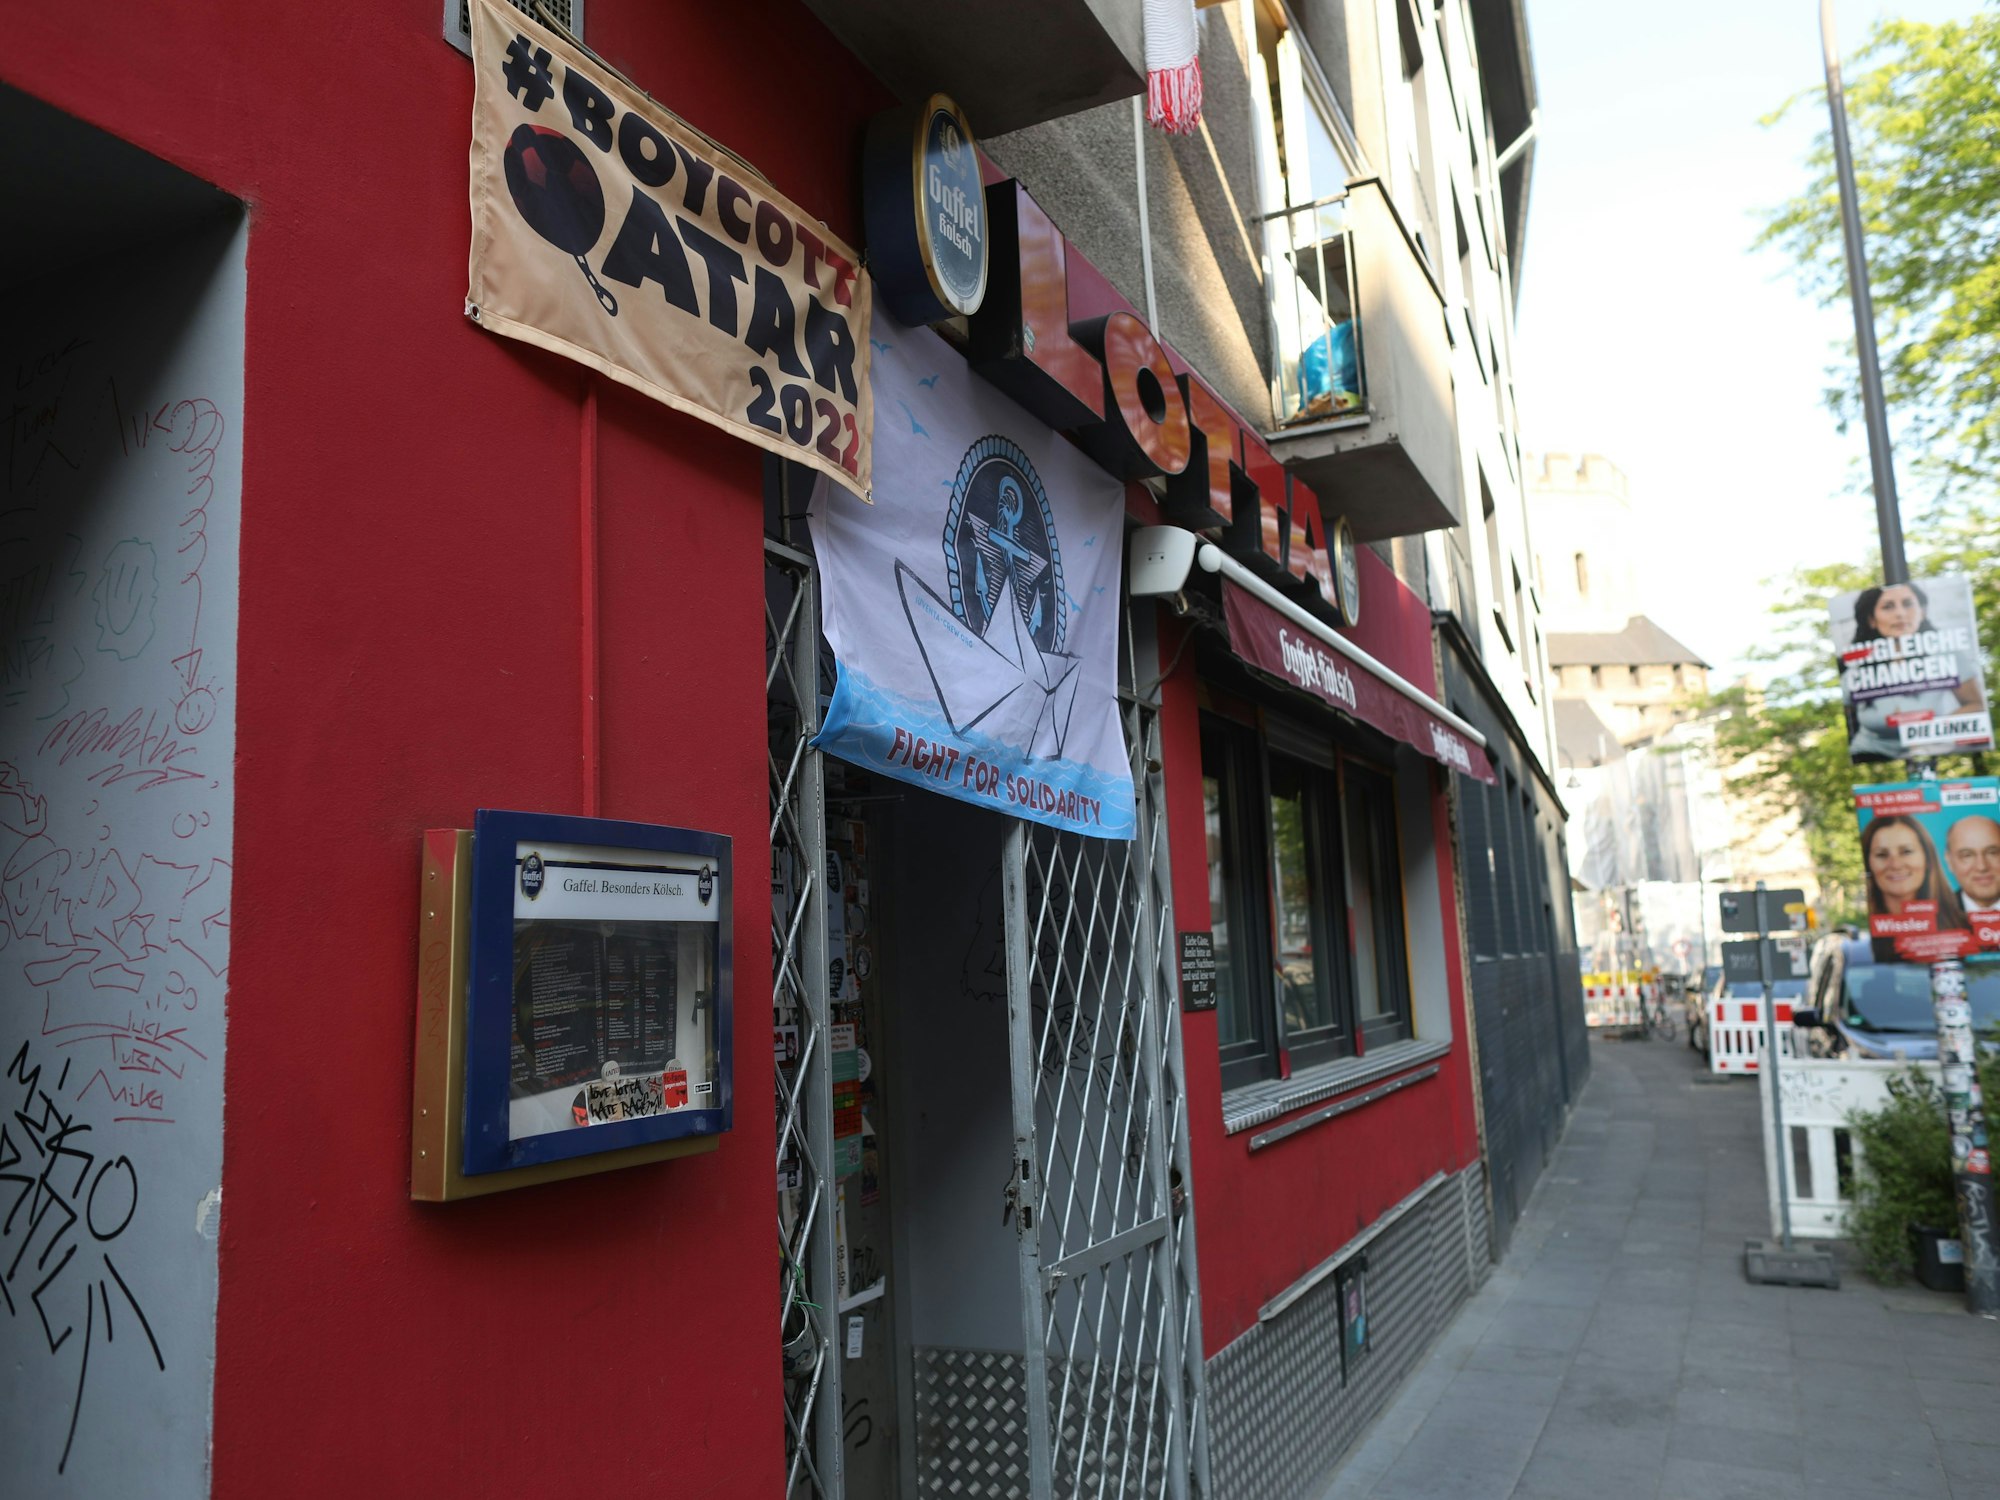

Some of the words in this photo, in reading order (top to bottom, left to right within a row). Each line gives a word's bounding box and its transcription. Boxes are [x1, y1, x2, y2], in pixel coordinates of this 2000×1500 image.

[502, 33, 858, 309] #BOYCOTT
[929, 164, 981, 243] Gaffel
[939, 213, 972, 260] Kölsch
[748, 365, 860, 477] 2022
[1846, 654, 1959, 692] CHANCEN
[1907, 723, 1931, 739] DIE
[887, 727, 960, 782] FIGHT
[963, 757, 1000, 799] FOR
[1005, 772, 1102, 826] SOLIDARITY
[522, 870, 542, 881] Gaffel
[563, 878, 599, 893] Gaffel.
[601, 880, 651, 895] Besonders
[653, 882, 684, 896] Kölsch.
[1874, 918, 1930, 933] Wissler
